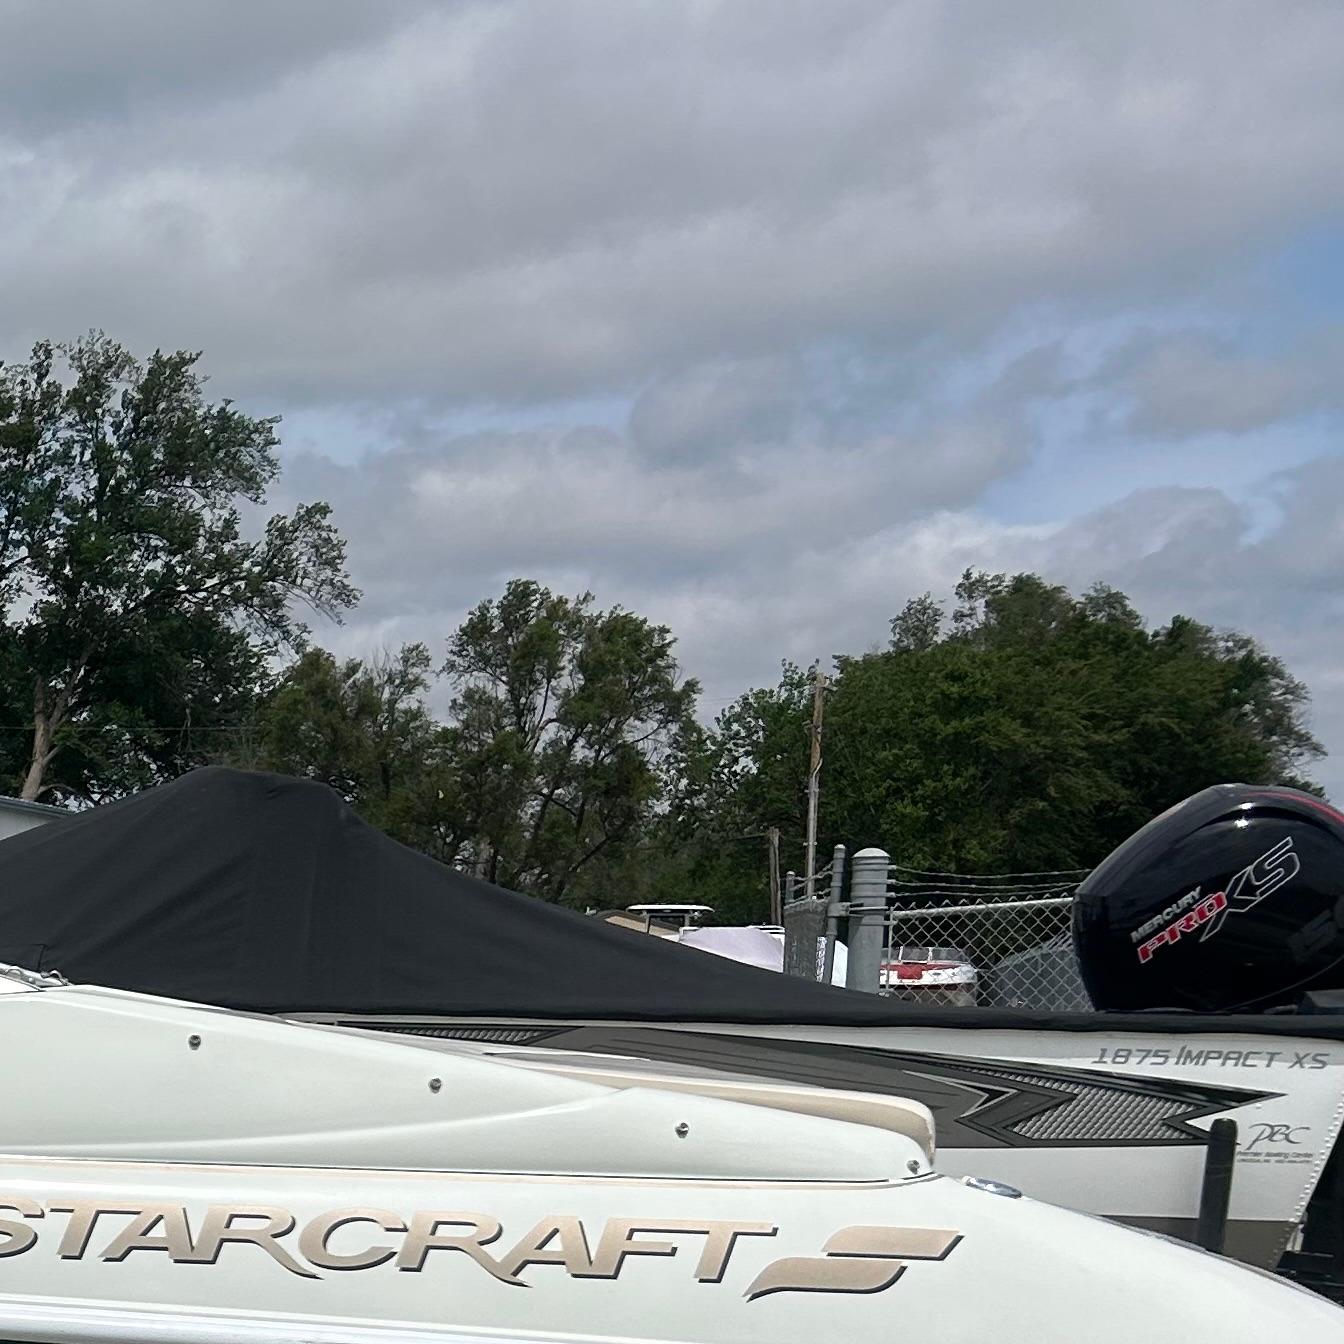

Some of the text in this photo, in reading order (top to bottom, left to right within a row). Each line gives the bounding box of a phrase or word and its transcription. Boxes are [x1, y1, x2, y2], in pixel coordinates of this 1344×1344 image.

[1130, 886, 1202, 943] MERCURY
[1091, 1045, 1330, 1070] 1875 IMPACT XS
